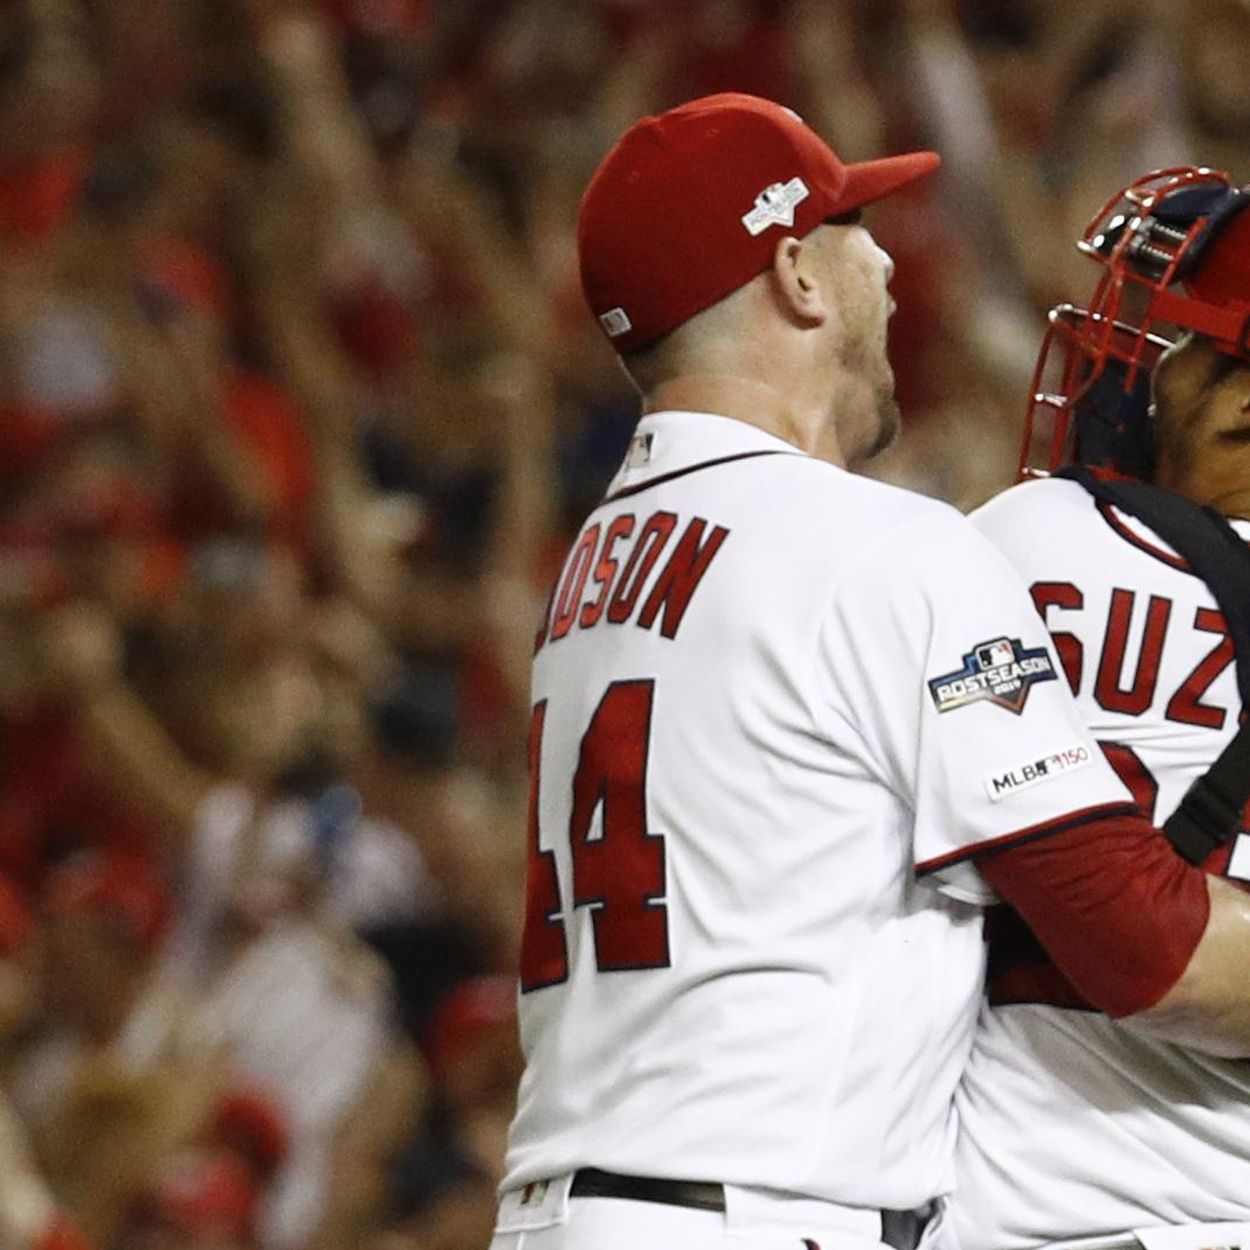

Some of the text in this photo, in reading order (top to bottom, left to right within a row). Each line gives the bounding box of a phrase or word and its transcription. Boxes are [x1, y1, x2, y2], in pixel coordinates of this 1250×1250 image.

[533, 510, 731, 656] DSON
[937, 656, 1051, 701] POSTSEASON
[992, 765, 1037, 793] MLB
